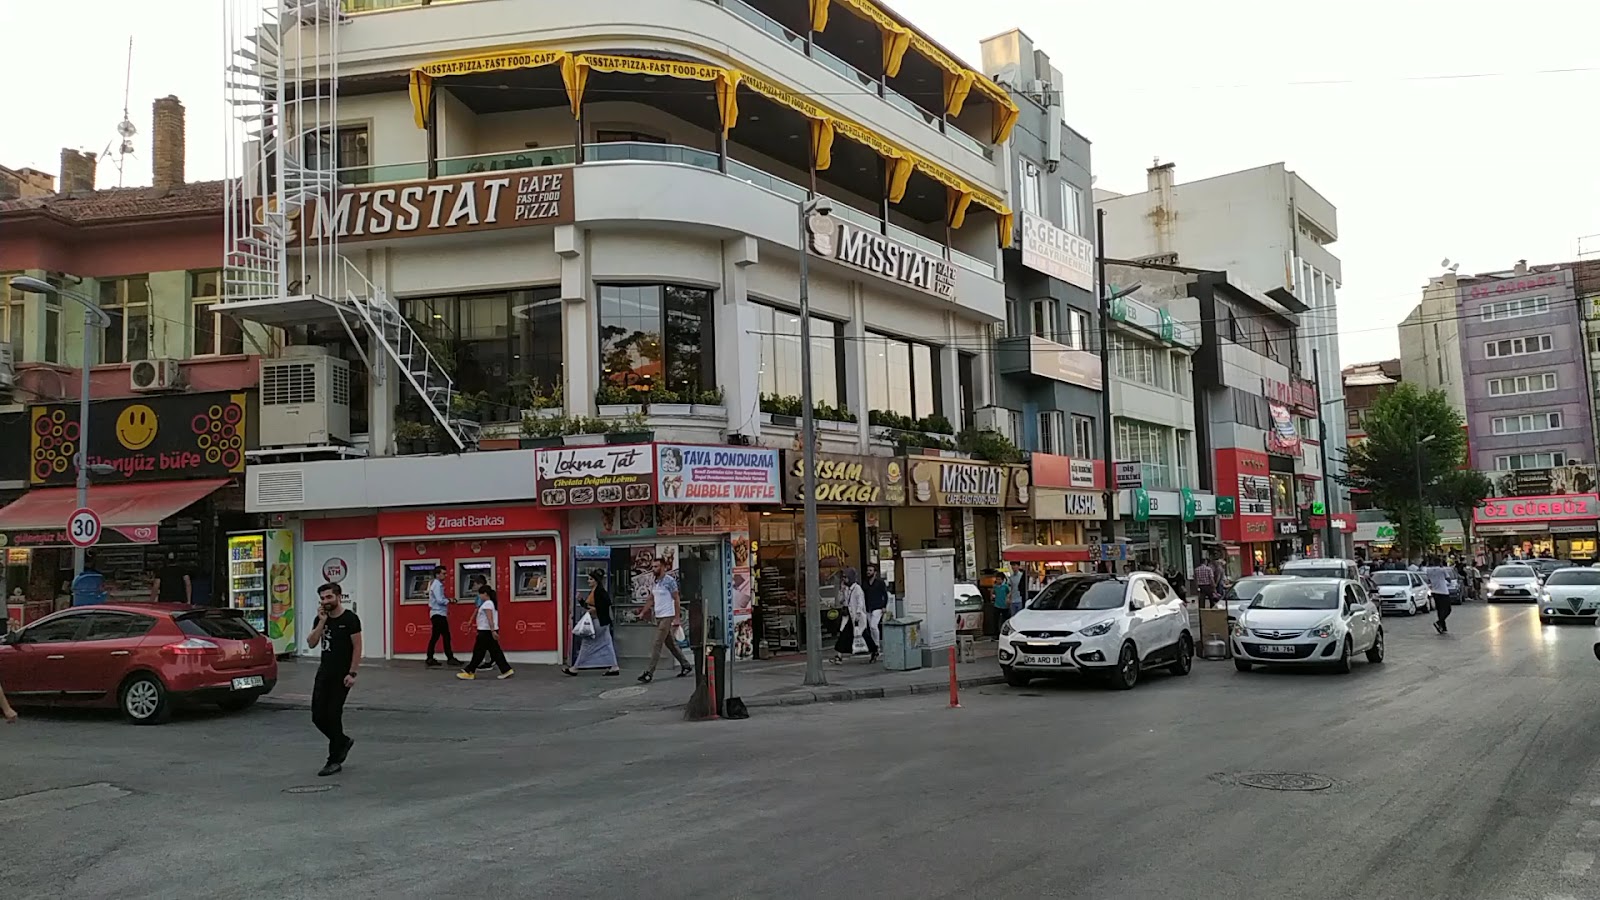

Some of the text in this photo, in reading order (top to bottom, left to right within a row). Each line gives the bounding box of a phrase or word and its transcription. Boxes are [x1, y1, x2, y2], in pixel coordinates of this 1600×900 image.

[518, 173, 563, 194] CAFE
[516, 191, 560, 203] FAST FOOD
[1037, 223, 1092, 263] GELECEK
[159, 451, 200, 470] büfe
[554, 449, 644, 474] Lokma Tat
[683, 450, 774, 468] TAVA DONDURMA
[685, 483, 776, 499] BUBBLE WAFFLE
[1065, 494, 1097, 515] KASHA
[1484, 498, 1588, 517] ÖZ GÜRBÜZ
[74, 519, 94, 537] 30
[438, 514, 504, 529] Ziraat Bankası
